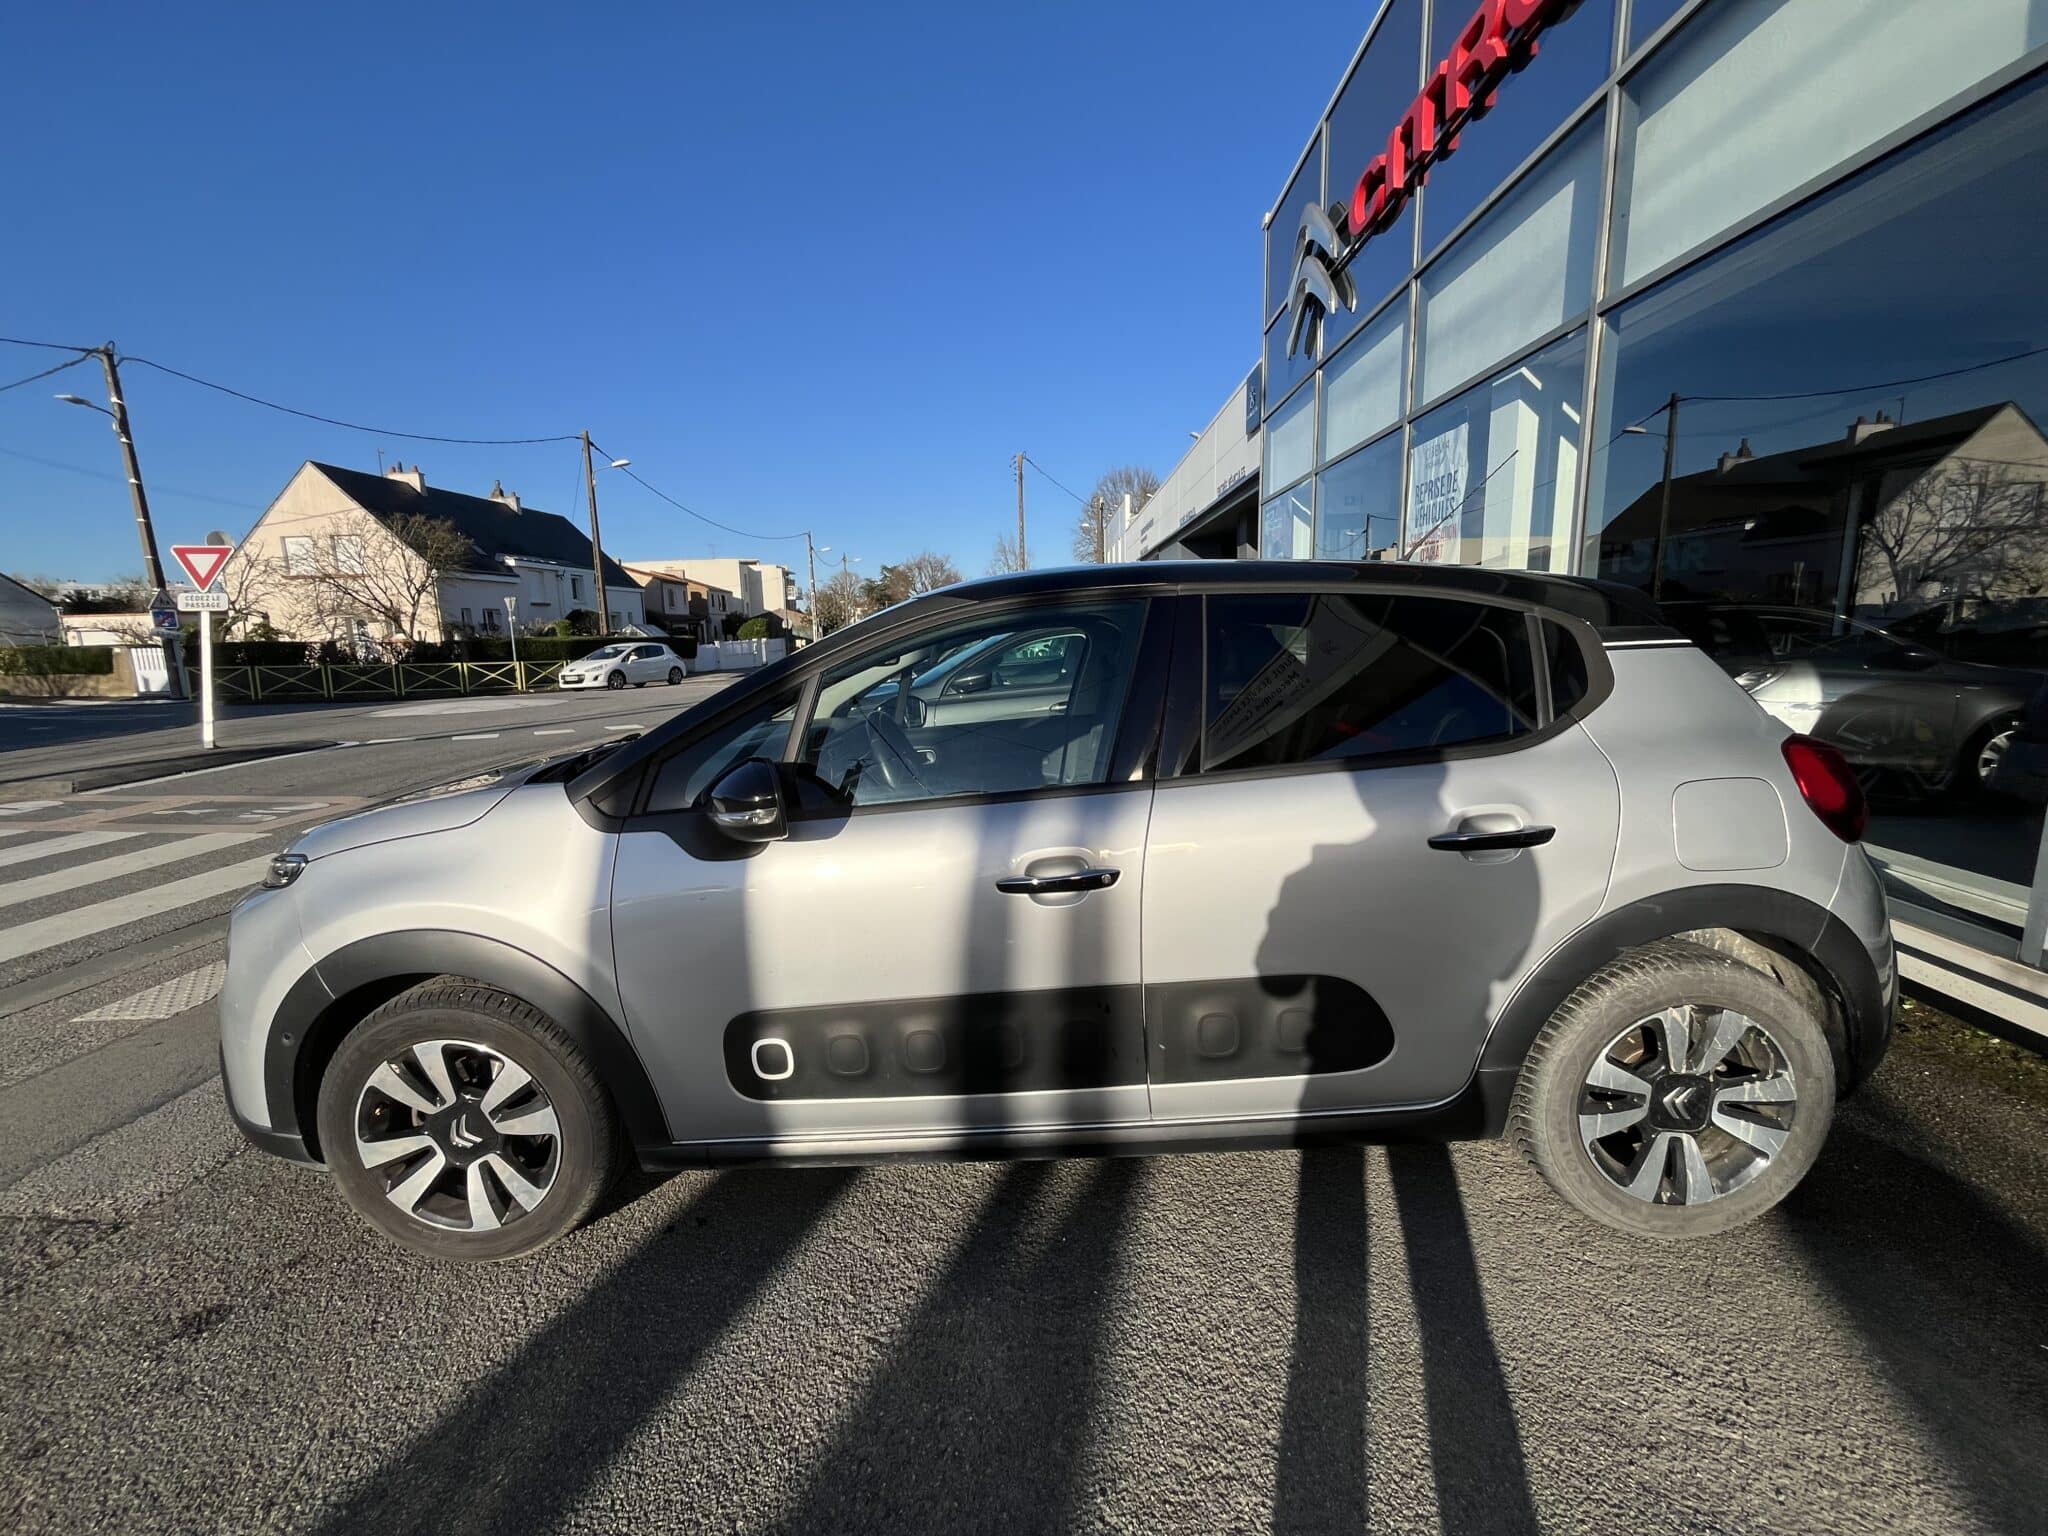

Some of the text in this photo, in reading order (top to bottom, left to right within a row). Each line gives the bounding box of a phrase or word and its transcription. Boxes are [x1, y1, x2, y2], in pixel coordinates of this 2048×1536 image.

[1348, 0, 1550, 236] CITR
[1415, 470, 1459, 504] REPRISE DE
